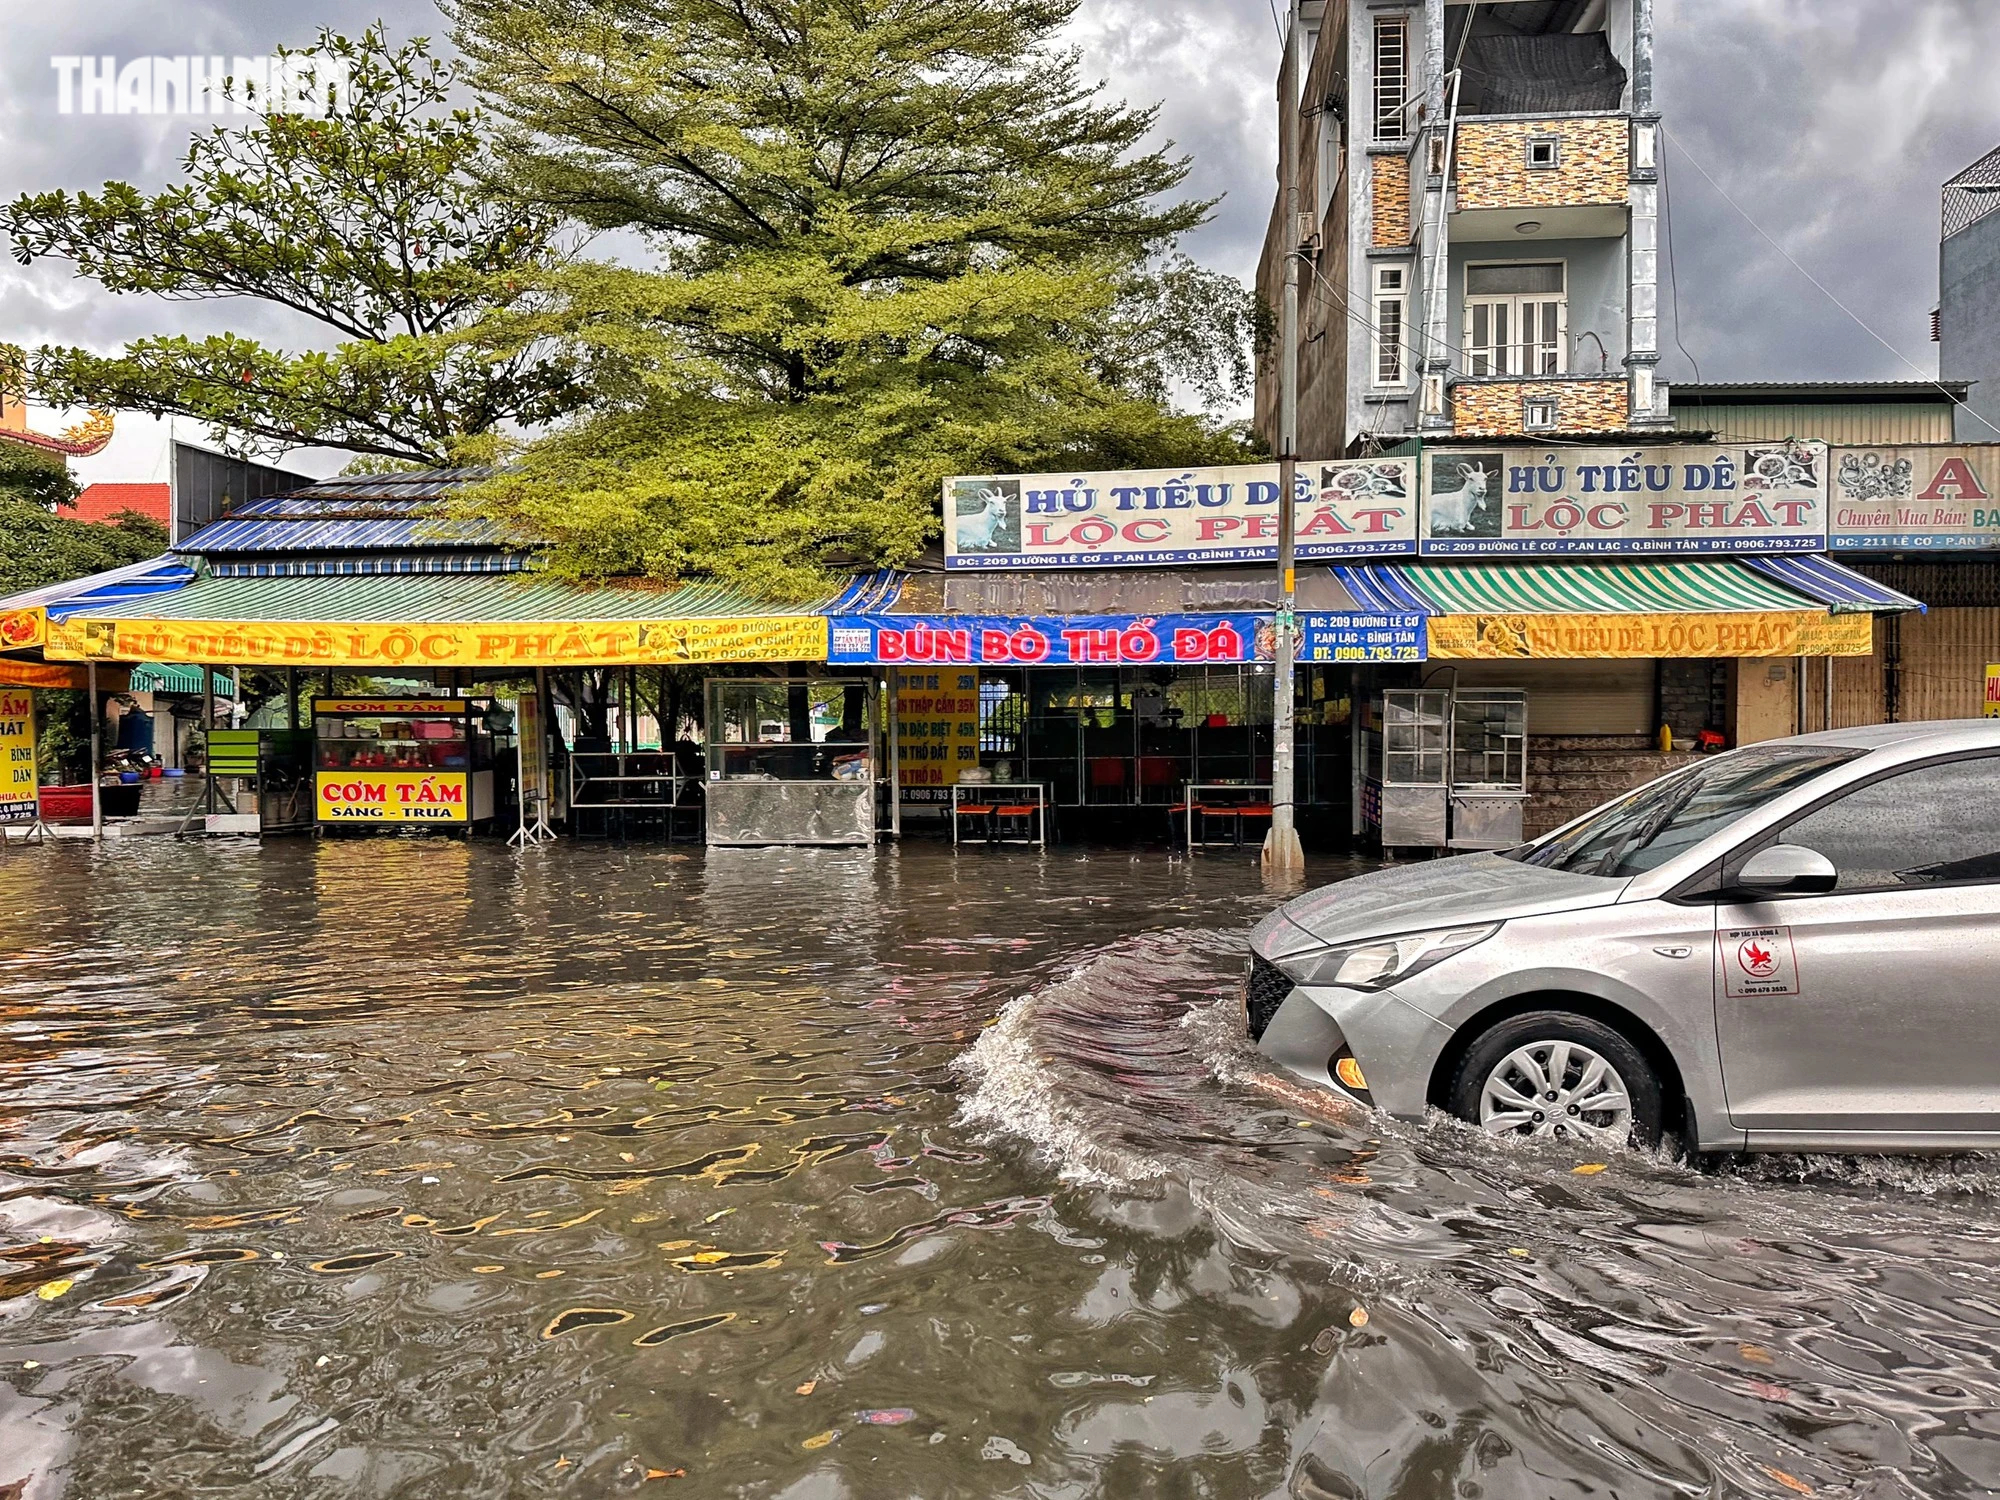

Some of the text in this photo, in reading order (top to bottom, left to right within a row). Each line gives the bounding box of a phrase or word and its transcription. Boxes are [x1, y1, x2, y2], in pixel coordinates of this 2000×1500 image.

[1508, 451, 1737, 493] HỦ TIẾU DÊ
[1916, 456, 1991, 500] A
[1025, 472, 1316, 514] HỦ TIẾU DÊ
[1507, 492, 1816, 537] LỘC PHÁT
[1837, 508, 1890, 528] Chuyên
[1895, 508, 1928, 525] Mua
[1933, 508, 1967, 525] Bán:
[1025, 504, 1406, 550] LỘC PHÁT
[1430, 543, 1450, 551] ĐC:
[1453, 543, 1475, 551] 209
[1478, 541, 1519, 551] ĐƯỜNG
[1522, 539, 1537, 551] LÊ
[1544, 541, 1557, 551] CƠ
[1567, 542, 1595, 551] P.AN
[1598, 541, 1621, 553] LẠC
[1631, 539, 1672, 551] Q.BÌNH
[1675, 538, 1699, 549] TÂN
[1711, 540, 1731, 549] ĐT:
[1734, 538, 1817, 549] 0906.793.725
[1836, 538, 1859, 547] ĐC:
[1862, 537, 1888, 547] 211
[1892, 535, 1909, 546] LÊ
[1913, 536, 1933, 546] CƠ
[1946, 537, 1976, 546] P.AN
[956, 558, 980, 566] ĐC:
[983, 557, 1009, 566] 209
[1012, 554, 1058, 566] ĐƯỜNG
[1061, 553, 1078, 564] LÊ
[1082, 554, 1101, 563] CƠ
[1113, 553, 1145, 562] P.AN
[1148, 552, 1175, 563] LẠC
[1187, 549, 1234, 560] Q.BÌNH
[1238, 548, 1266, 558] TÂN
[1308, 542, 1406, 555] 0906.793.725
[692, 625, 711, 635] ĐC:
[715, 623, 738, 635] 209
[742, 620, 782, 633] ĐƯỜNG
[803, 619, 821, 631] CƠ
[1310, 617, 1327, 627] ĐC:
[1330, 616, 1350, 627] 209
[1352, 614, 1387, 627] ĐƯỜNG
[1389, 614, 1402, 627] LÊ
[1404, 615, 1419, 627] CƠ
[691, 638, 718, 648] P.AN
[721, 637, 744, 649] LẠC
[799, 634, 821, 645] TÂN
[878, 622, 971, 661] BÚN
[981, 623, 1049, 661] BÒ
[1061, 618, 1160, 661] THỐ
[1171, 621, 1243, 661] ĐÁ
[1313, 632, 1336, 643] P.AN
[1338, 632, 1358, 645] LẠC
[1367, 630, 1393, 643] BÌNH
[1395, 630, 1416, 643] TÂN
[1565, 616, 1613, 652] TIẾU
[1618, 620, 1645, 651] DÊ
[1715, 615, 1793, 651] PHÁT
[117, 624, 634, 664] HỦ TIẾU DÊ LỘC PHÁT
[1313, 646, 1419, 660] ĐT: 0906.793.725
[691, 647, 820, 660] ĐT: 0906.793.725
[957, 675, 976, 690] 25K
[335, 701, 446, 712] CƠM TẤM
[910, 695, 933, 716] THẬP
[957, 698, 976, 713] 35K
[957, 722, 976, 737] 45K
[11, 744, 32, 762] BÌNH
[909, 740, 929, 760] THỐ
[957, 745, 976, 760] 55K
[13, 765, 31, 783] DÂN
[909, 764, 929, 784] THỐ
[930, 765, 943, 784] ĐÁ
[321, 775, 463, 804] CƠM TẤM
[910, 789, 931, 800] 0906
[933, 789, 948, 800] 793
[331, 804, 384, 817] SÁNG
